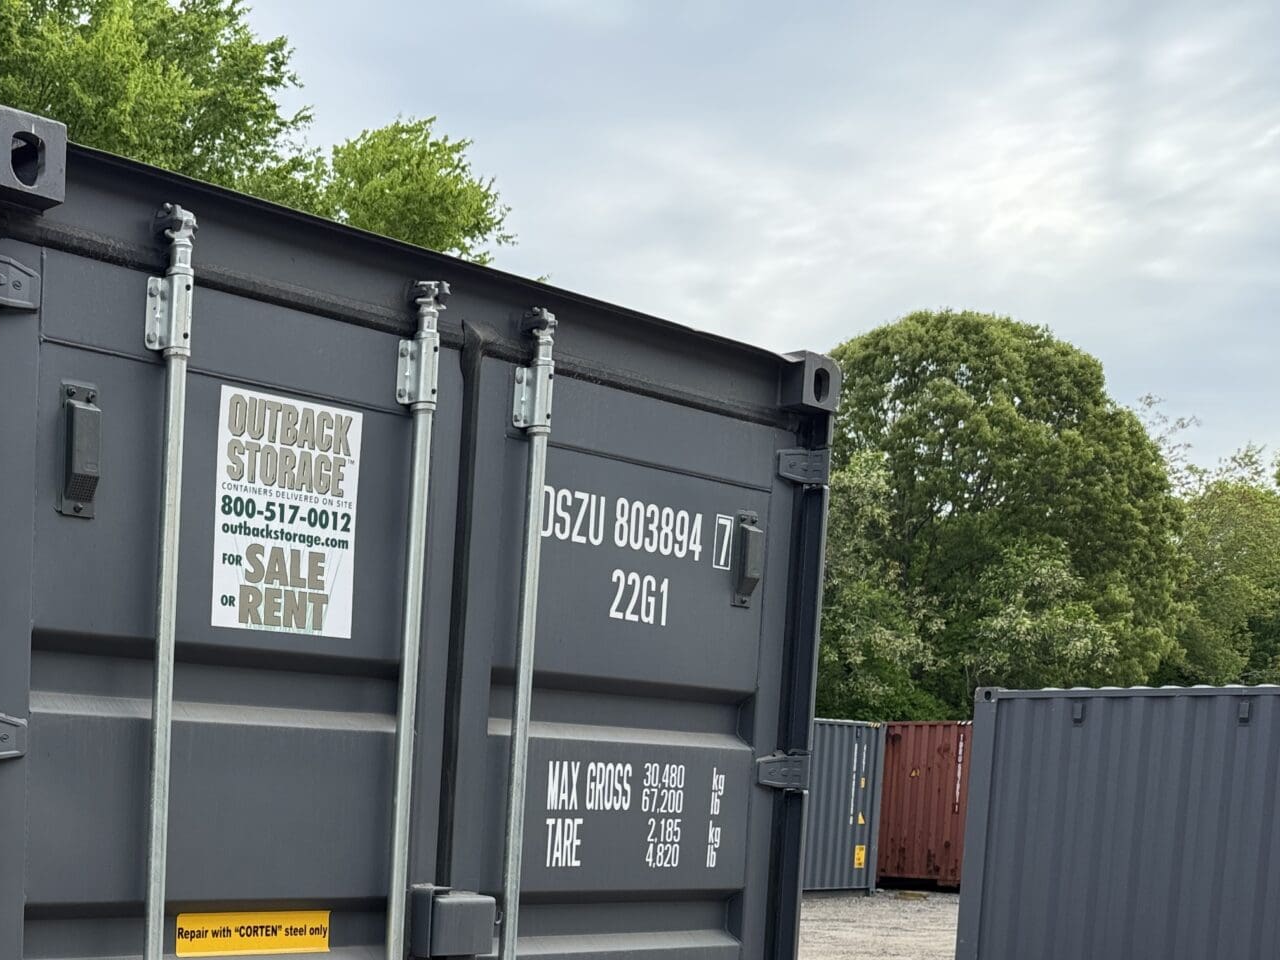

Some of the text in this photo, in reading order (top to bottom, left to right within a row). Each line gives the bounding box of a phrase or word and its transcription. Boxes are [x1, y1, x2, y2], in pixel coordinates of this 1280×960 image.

[227, 393, 353, 457] OUTBACK
[226, 438, 346, 498] STORAGE
[221, 494, 352, 533] 800-517-0012
[222, 482, 352, 510] CONTAINERS DELIVERED ON SITE
[222, 521, 349, 550] outbackstorage.com
[540, 484, 733, 568] DSZU 803894 7
[222, 543, 326, 591] FOR SALE
[220, 584, 329, 631] OR RENT
[609, 569, 669, 627] 22G1
[546, 760, 726, 811] MAX GROSS 30,480 kg
[641, 788, 720, 816] 67,200 lb
[545, 818, 721, 868] TARE 2,185 kg
[645, 843, 717, 869] 4,820 lb
[177, 927, 209, 942] Repair
[211, 926, 232, 938] with
[284, 924, 307, 937] steel
[309, 924, 328, 938] only
